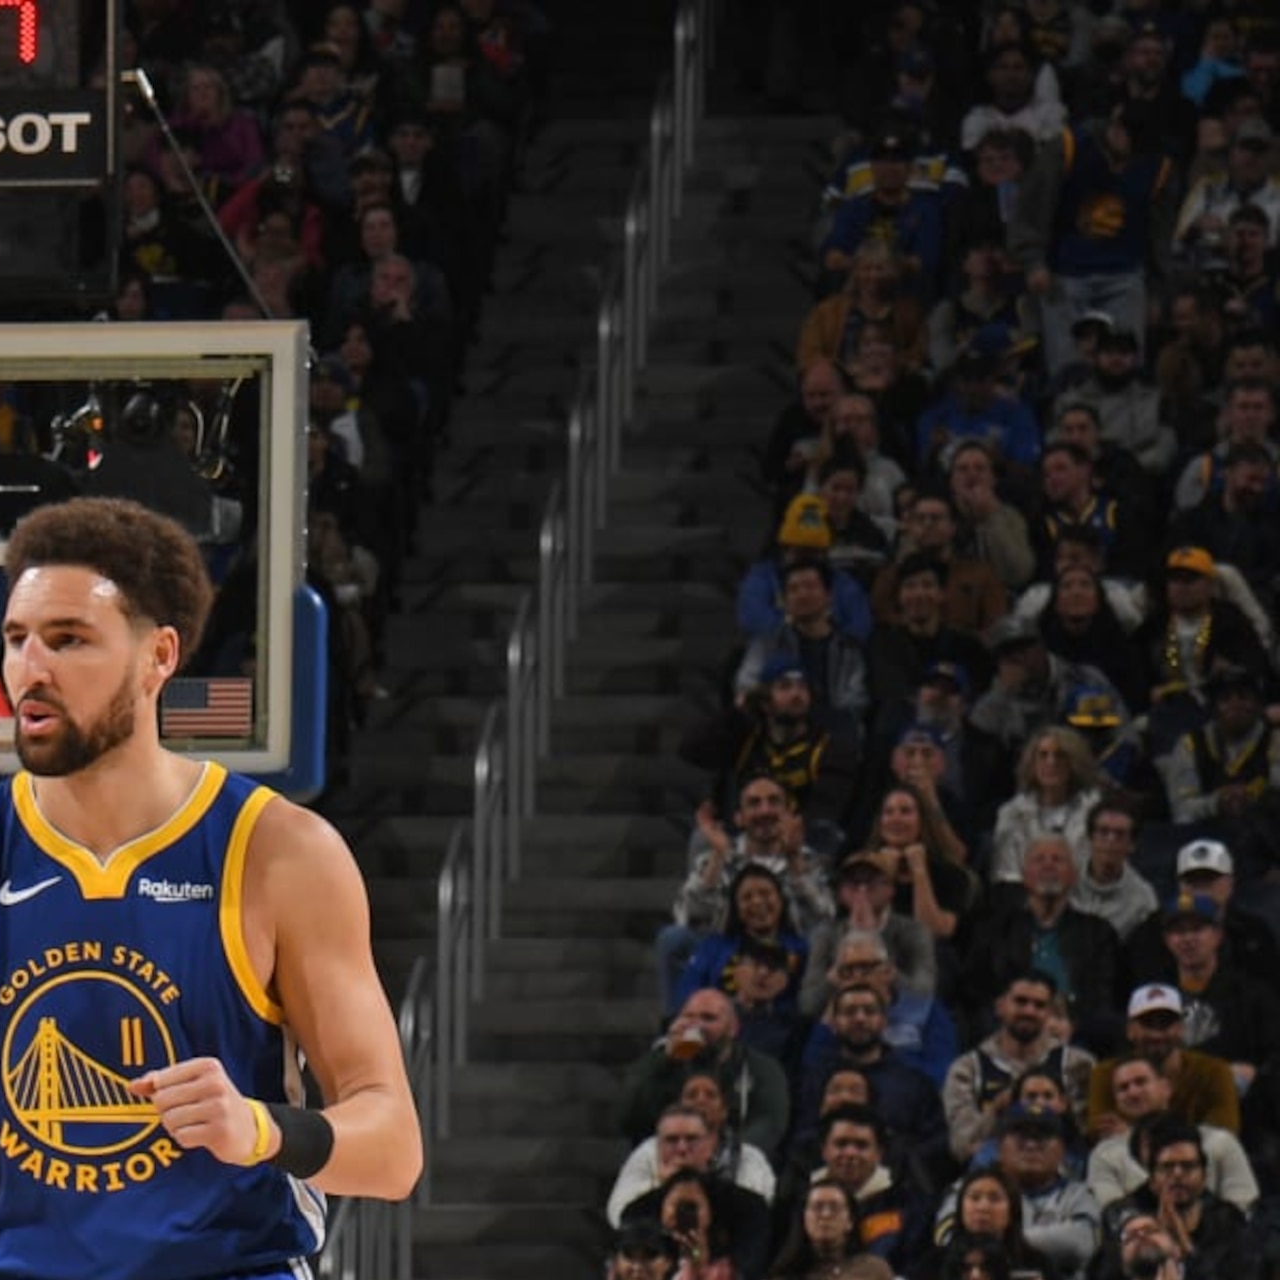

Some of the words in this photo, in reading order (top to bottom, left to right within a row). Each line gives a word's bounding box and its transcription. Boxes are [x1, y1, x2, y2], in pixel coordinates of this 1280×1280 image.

[138, 877, 213, 900] Rakuten
[112, 945, 180, 1005] STATE
[120, 1017, 144, 1066] 11
